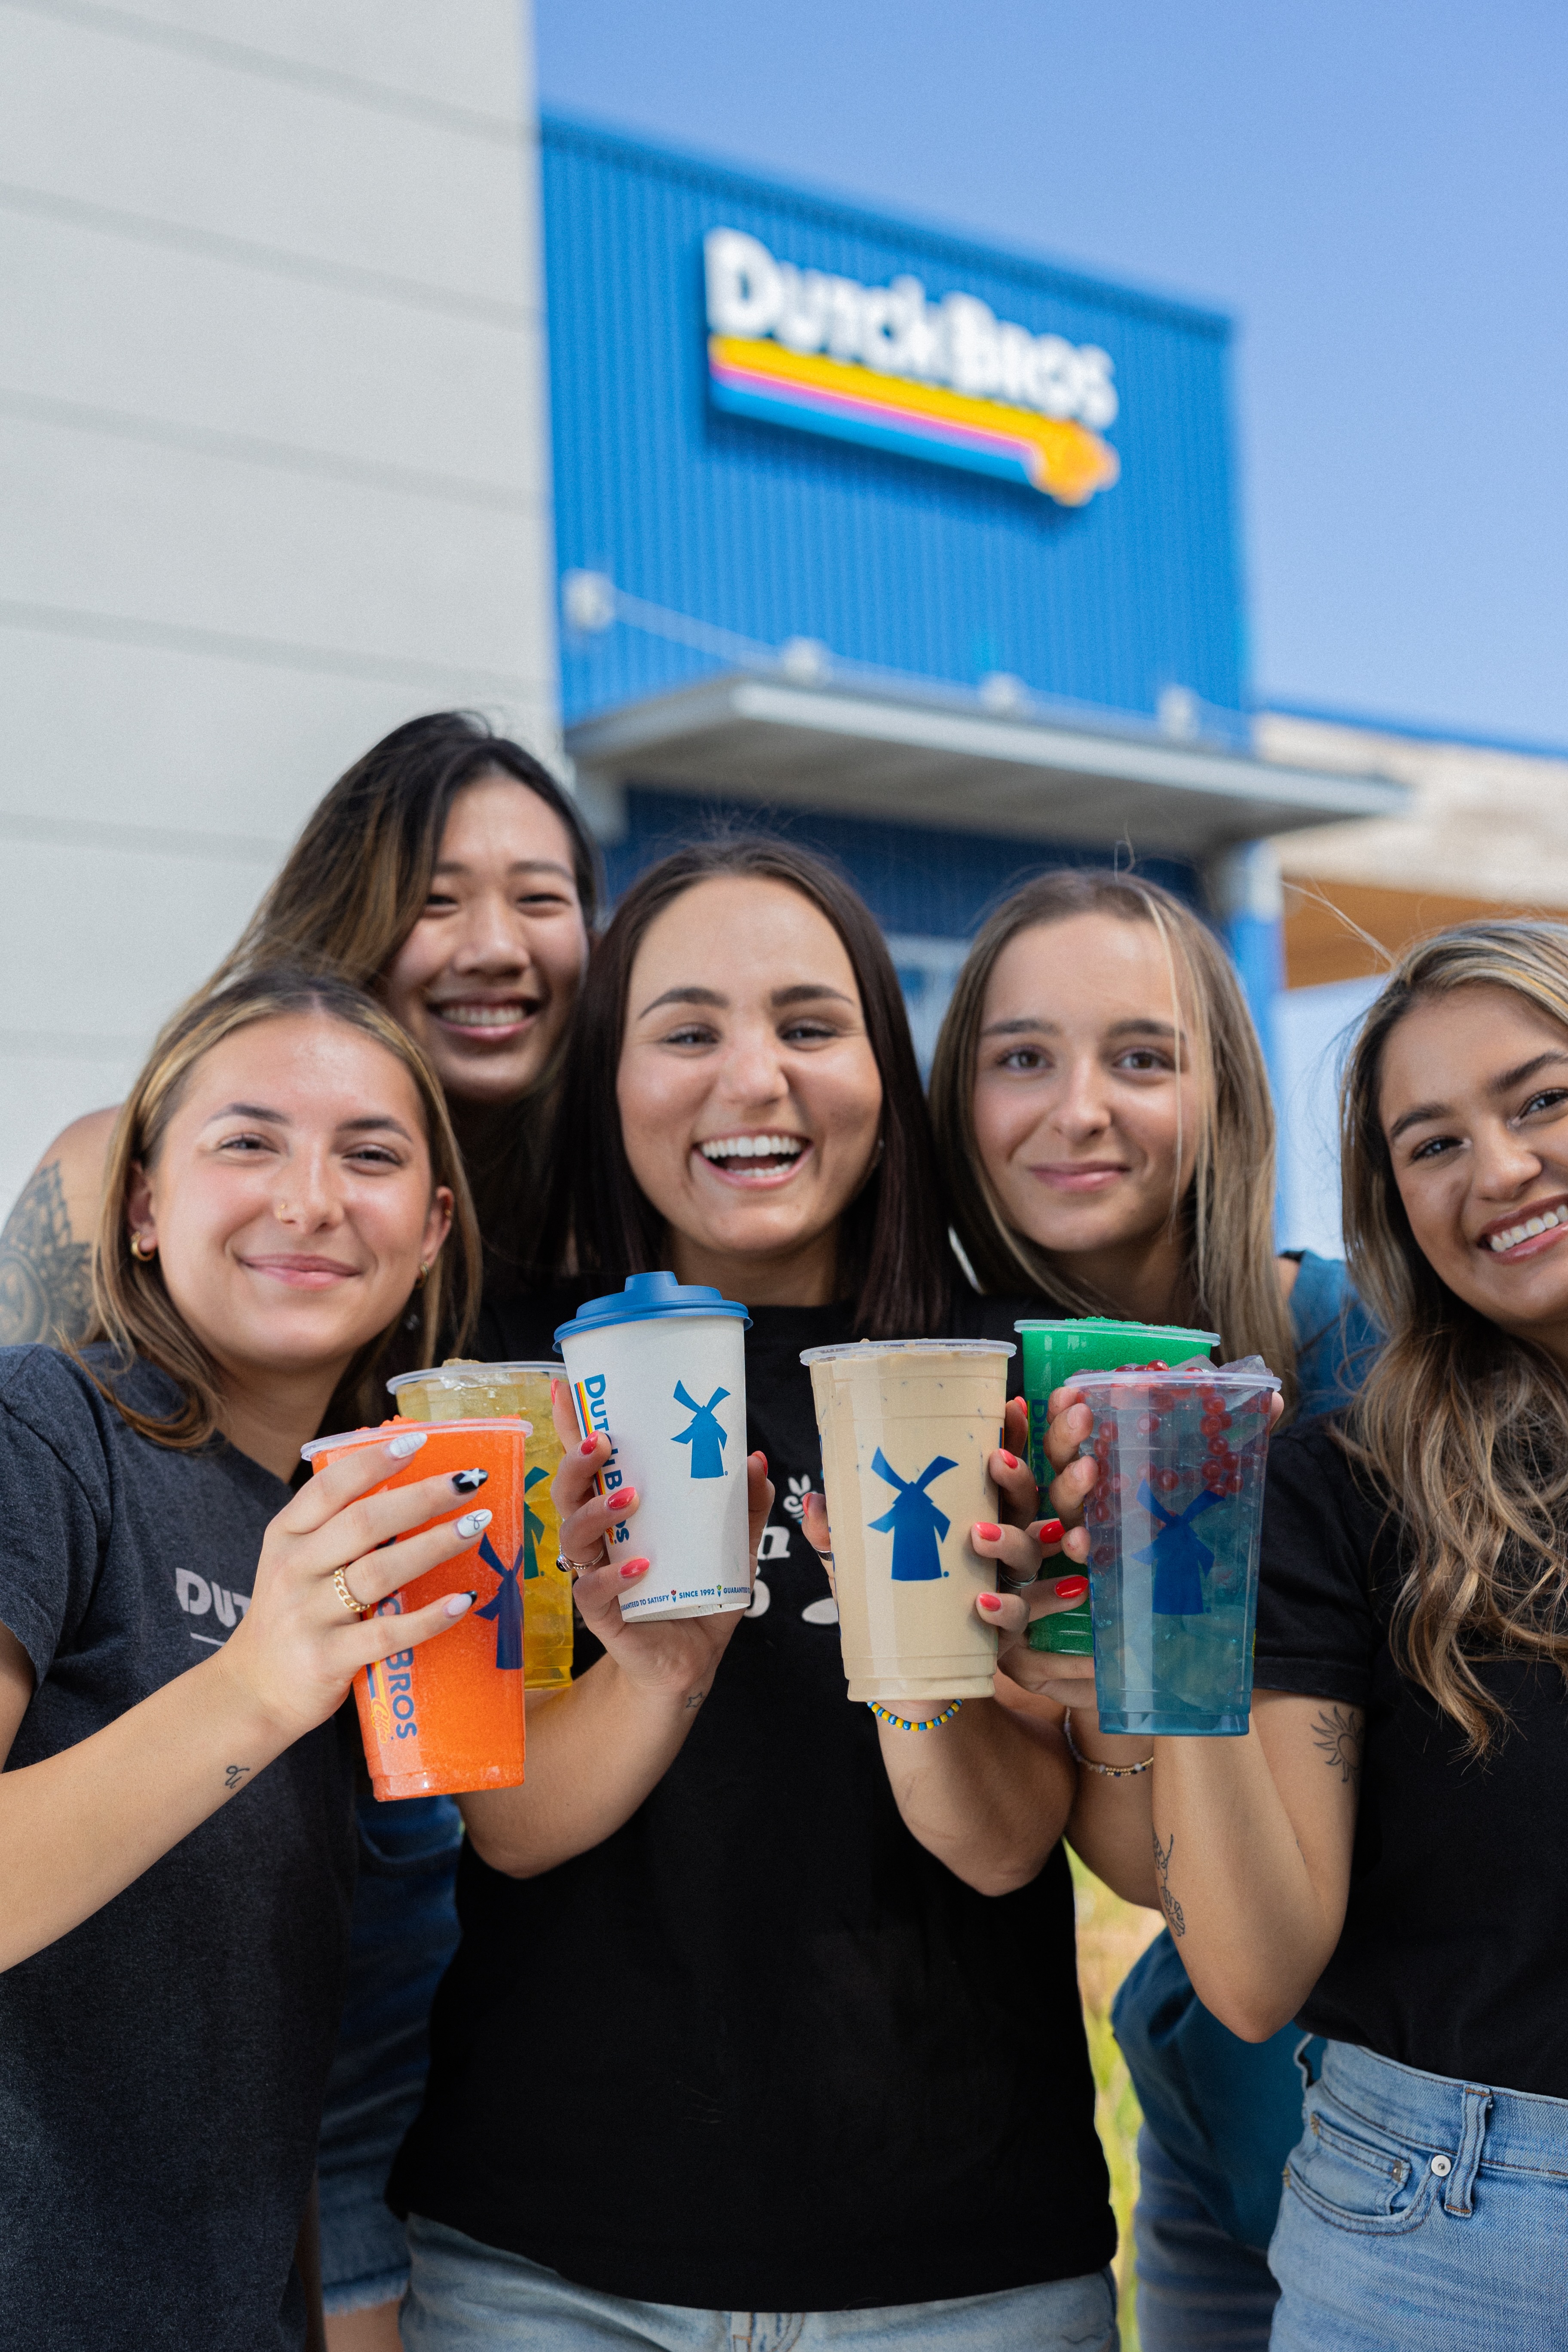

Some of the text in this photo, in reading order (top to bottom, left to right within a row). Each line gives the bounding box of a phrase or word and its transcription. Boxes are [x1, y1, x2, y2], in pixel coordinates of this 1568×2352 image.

[647, 1595, 669, 1604] SATISFY
[679, 1590, 698, 1599] SINCE
[386, 1647, 417, 1740] BROS
